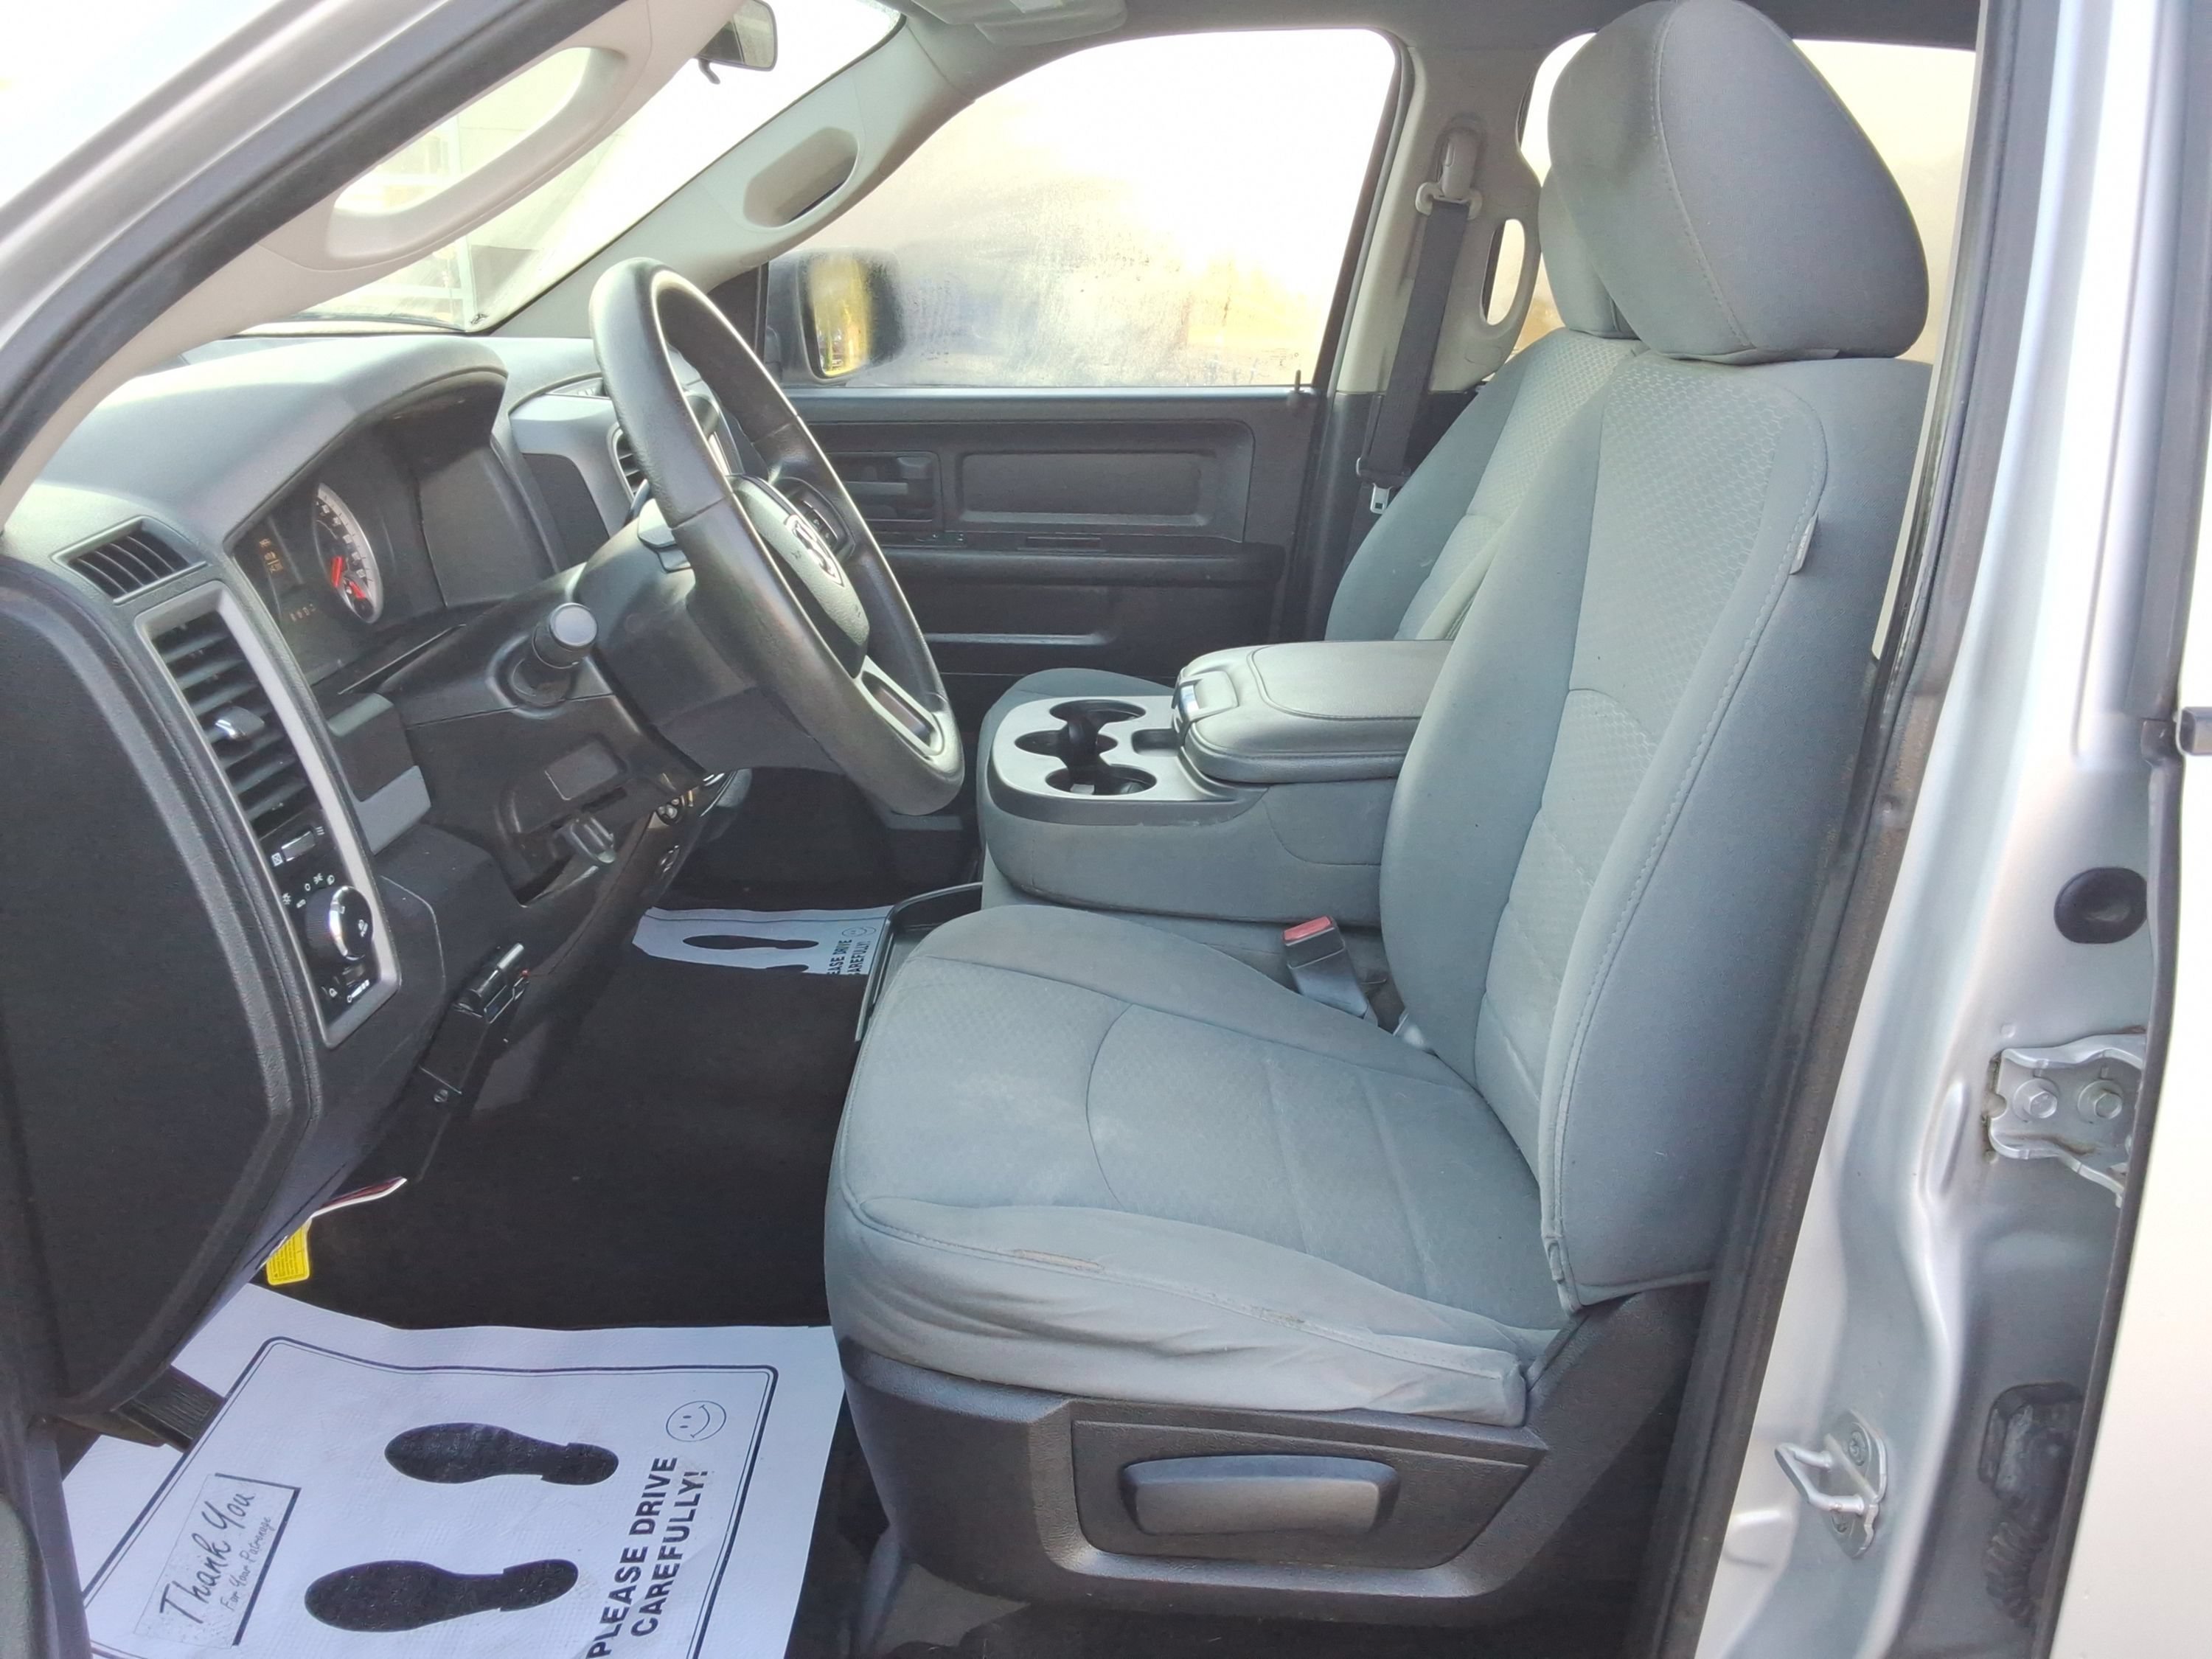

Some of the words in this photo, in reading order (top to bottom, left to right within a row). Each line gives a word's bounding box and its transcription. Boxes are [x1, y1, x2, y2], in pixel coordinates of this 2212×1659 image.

[826, 956, 845, 975] EASE
[846, 941, 872, 975] AREFULLY!
[159, 1532, 232, 1624] Thank
[201, 1492, 256, 1530] You
[239, 1516, 276, 1564] Patronage
[585, 1546, 649, 1659] PLEASE
[628, 1457, 678, 1536] DRIVE
[630, 1470, 709, 1638] CAREFULLY!
[229, 1565, 251, 1588] Your
[220, 1590, 242, 1613] For
